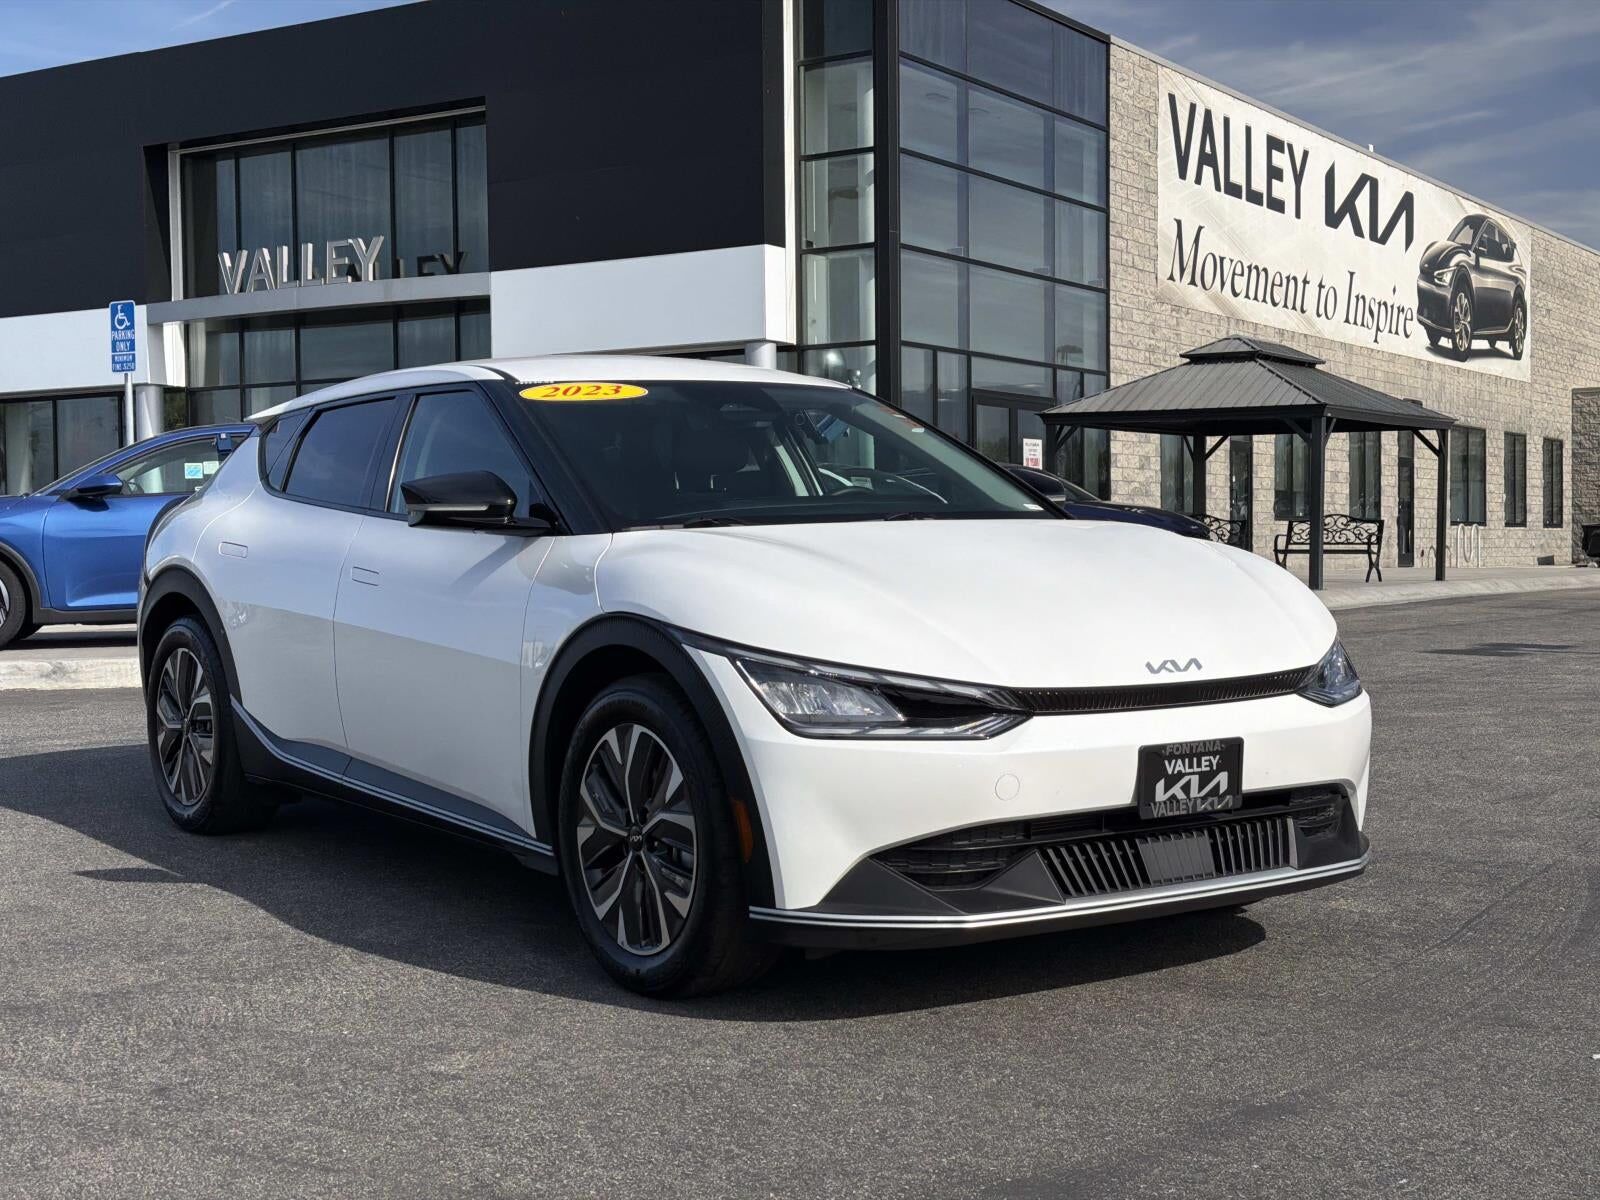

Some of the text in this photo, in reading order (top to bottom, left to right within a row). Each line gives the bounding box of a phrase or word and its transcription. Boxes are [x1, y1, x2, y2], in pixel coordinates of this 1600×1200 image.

[1168, 93, 1415, 254] VALLEY KIA
[217, 234, 385, 295] VALLEY
[1167, 218, 1415, 344] Movement to Inspire
[111, 330, 134, 341] PARKING
[116, 341, 130, 352] ONLY
[114, 354, 133, 362] MINIMUM
[541, 386, 622, 397] 2023
[1145, 657, 1203, 675] KIA
[1166, 740, 1222, 756] FONTANA
[1164, 755, 1219, 774] VALLEY
[1155, 771, 1229, 802] KIA
[1150, 799, 1195, 818] VALLEY
